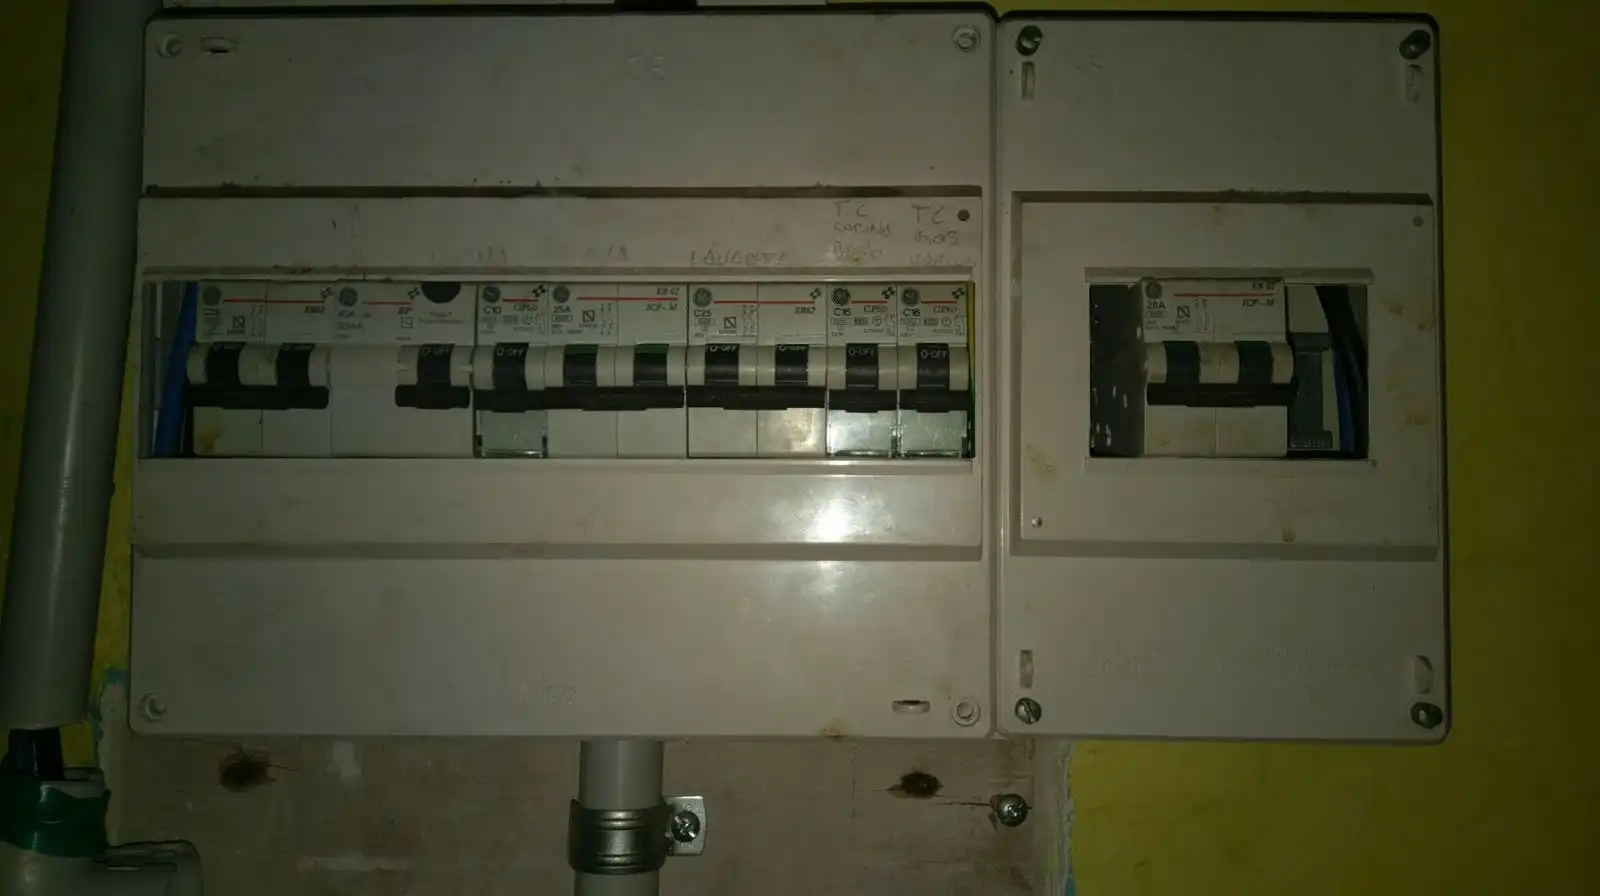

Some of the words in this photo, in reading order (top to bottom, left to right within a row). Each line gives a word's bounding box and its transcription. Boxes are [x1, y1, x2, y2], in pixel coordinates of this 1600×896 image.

[483, 304, 502, 315] C10
[552, 304, 571, 314] 25A
[694, 309, 712, 318] C25
